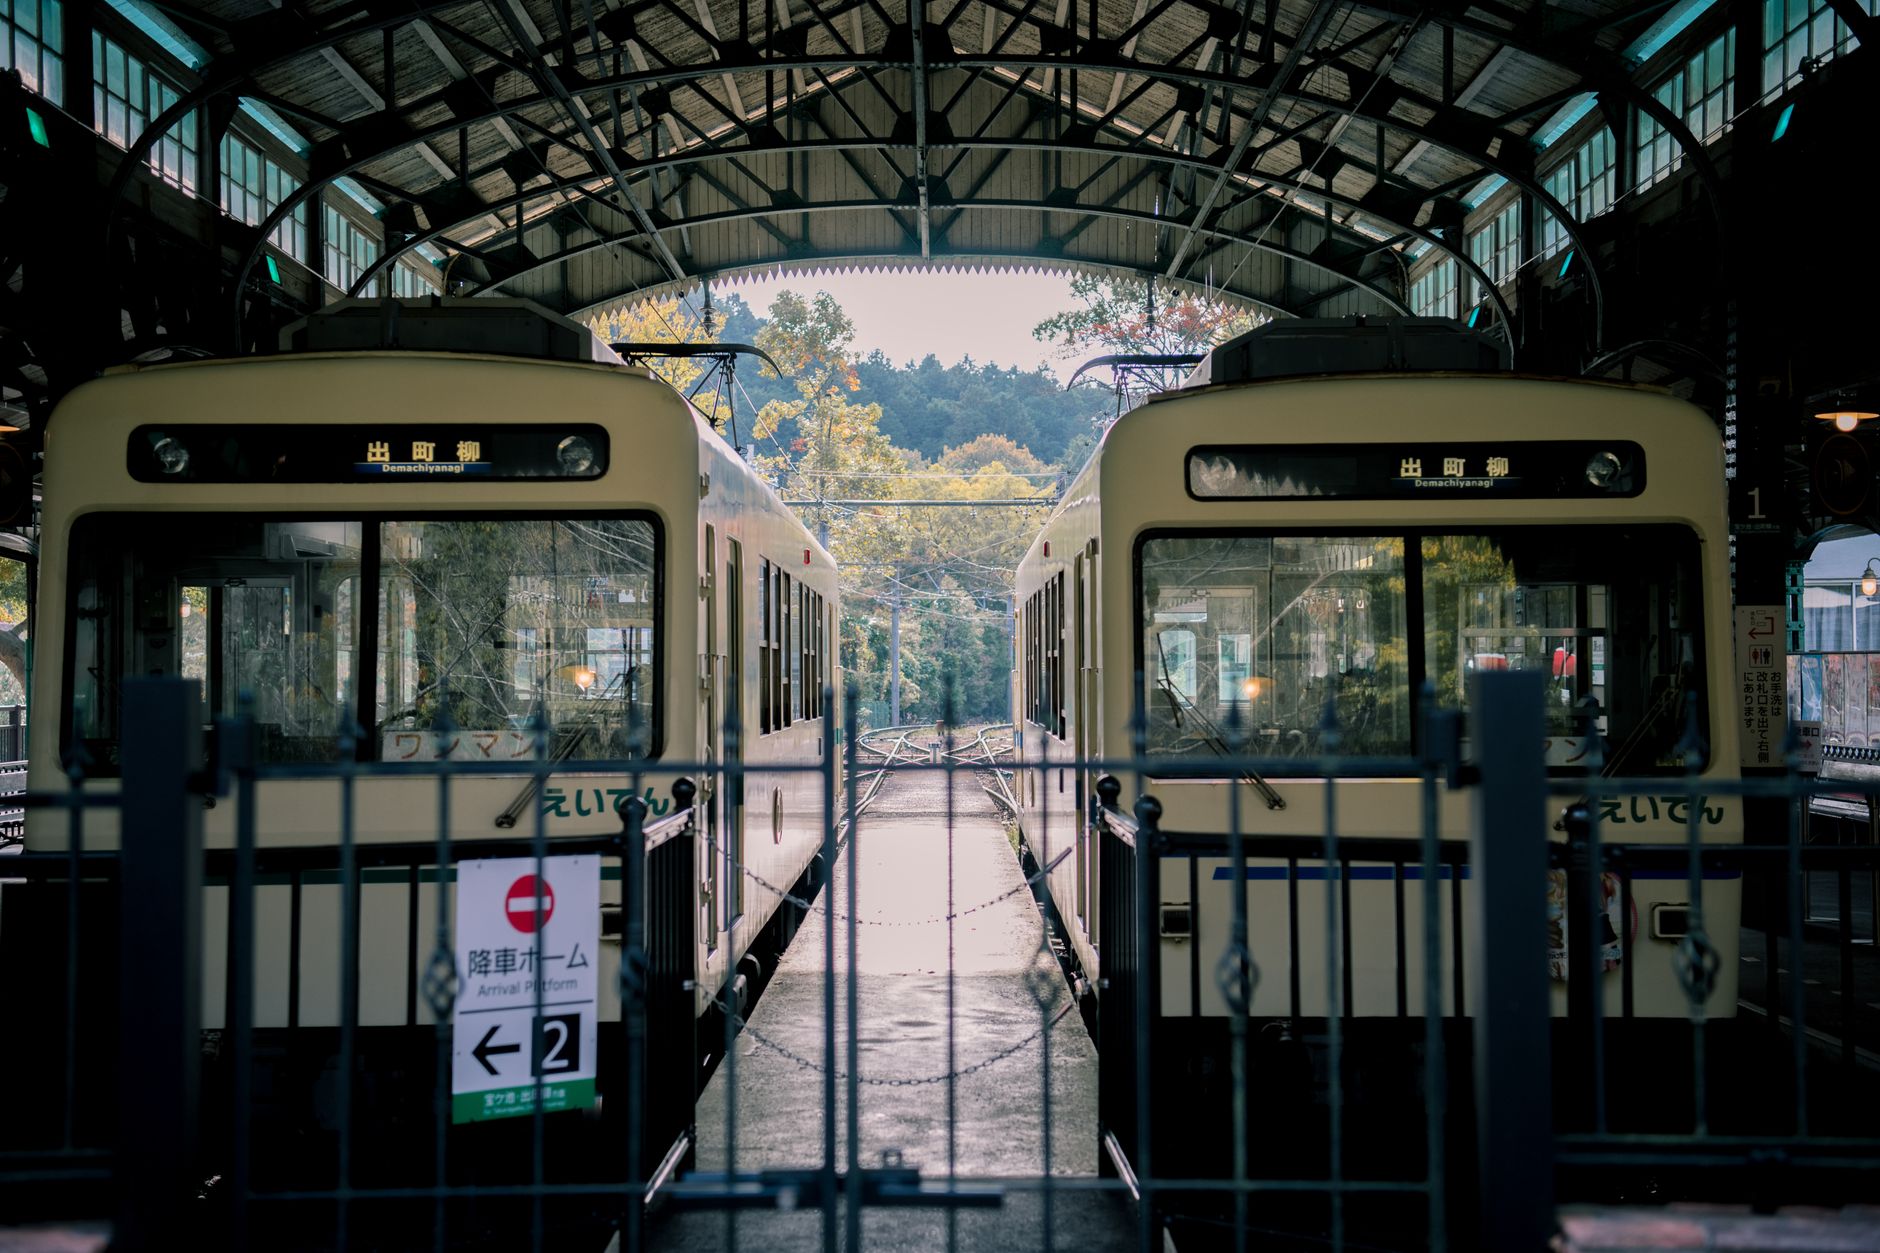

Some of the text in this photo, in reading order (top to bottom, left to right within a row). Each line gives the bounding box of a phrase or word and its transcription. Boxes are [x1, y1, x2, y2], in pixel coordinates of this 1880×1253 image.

[367, 440, 481, 462] 出町柳
[1400, 456, 1509, 477] 出町柳
[382, 463, 465, 474] Demachiyanagi
[1414, 478, 1494, 488] Demachiyanagi
[1747, 486, 1766, 519] 1
[1743, 672, 1755, 735] にあります。
[1770, 671, 1783, 717] お手洗は
[1756, 671, 1769, 763] 改札口を出て右側
[1597, 793, 1724, 824] えいでん
[468, 943, 589, 978] 降車ホーム
[478, 978, 578, 997] Arrival Pltform
[541, 1019, 570, 1070] 2
